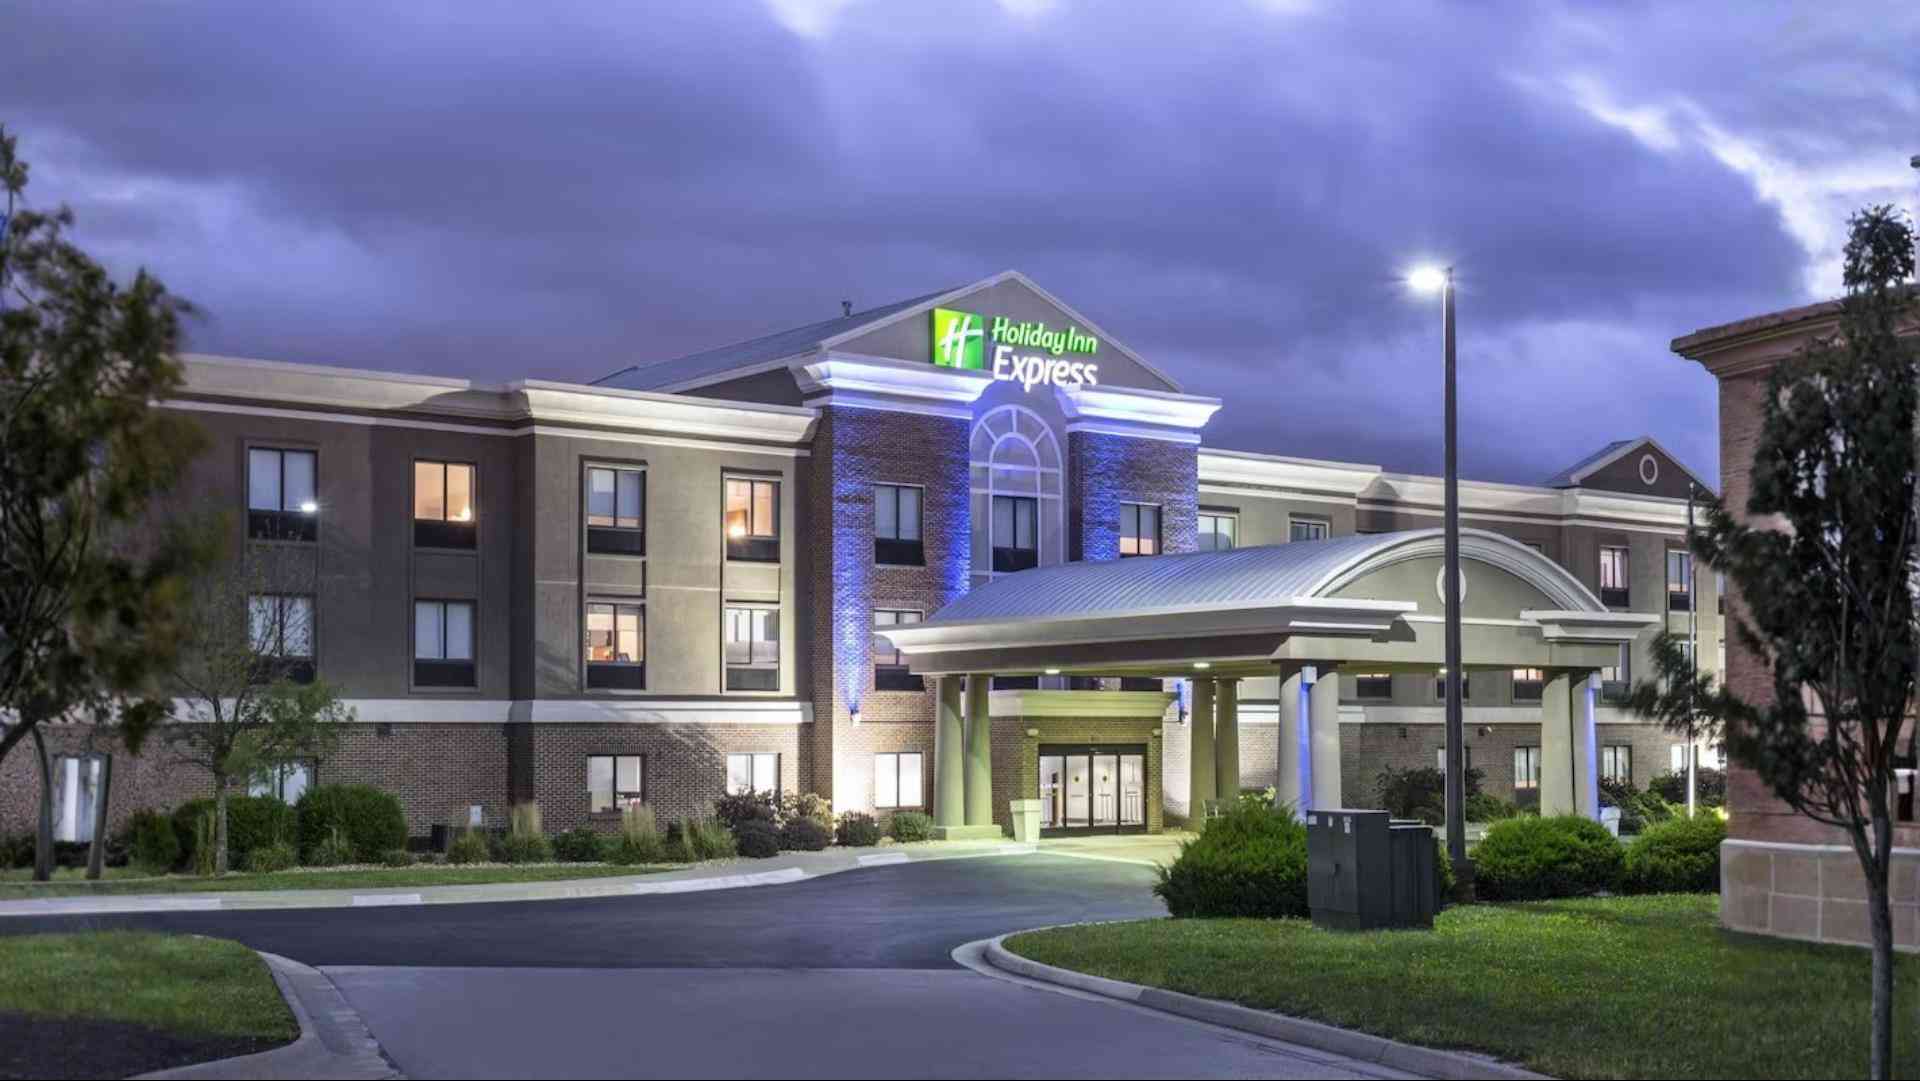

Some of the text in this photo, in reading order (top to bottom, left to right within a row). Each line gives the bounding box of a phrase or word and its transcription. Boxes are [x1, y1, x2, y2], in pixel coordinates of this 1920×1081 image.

[939, 315, 984, 369] H
[992, 316, 1098, 355] Holiday Inn
[992, 345, 1099, 393] Express
